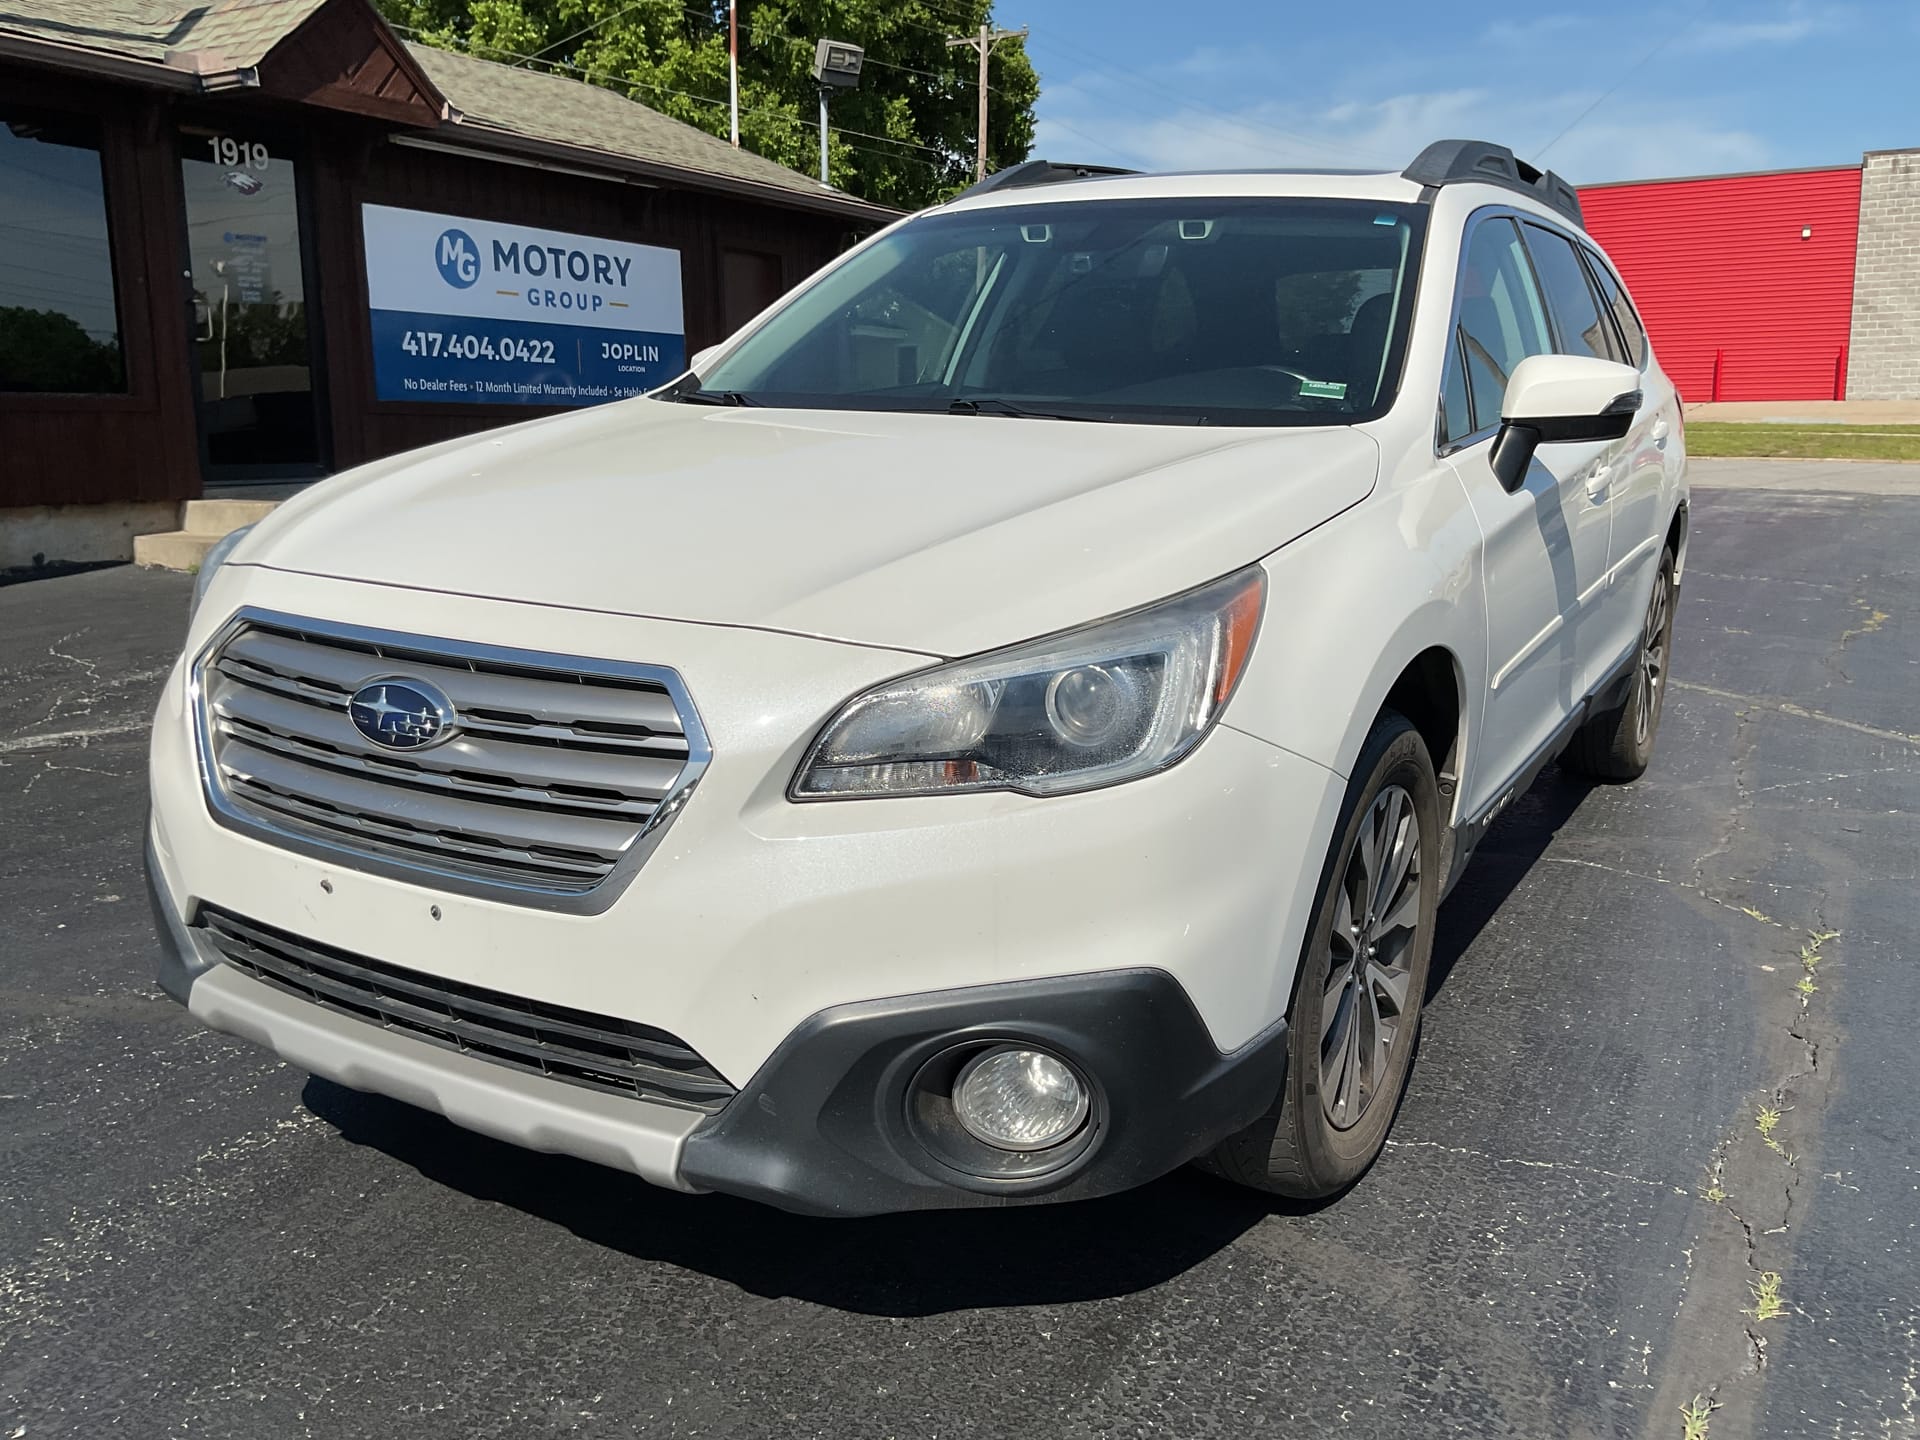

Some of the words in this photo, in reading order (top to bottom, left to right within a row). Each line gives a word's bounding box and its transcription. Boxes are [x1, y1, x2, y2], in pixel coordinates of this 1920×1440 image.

[208, 136, 269, 171] 1919
[492, 239, 632, 288] MOTORY
[527, 288, 603, 312] GROUP
[401, 331, 556, 364] 417.404.0422
[601, 342, 659, 362] JOPLIN
[618, 365, 646, 373] LOCATION
[404, 378, 418, 390] No
[420, 378, 448, 391] Dealer
[449, 380, 468, 392] Fees
[475, 381, 484, 393] 12
[486, 381, 512, 393] Month
[514, 382, 542, 394] Limited
[544, 384, 576, 398] Warranty
[578, 385, 608, 397] Included
[614, 386, 623, 397] Se
